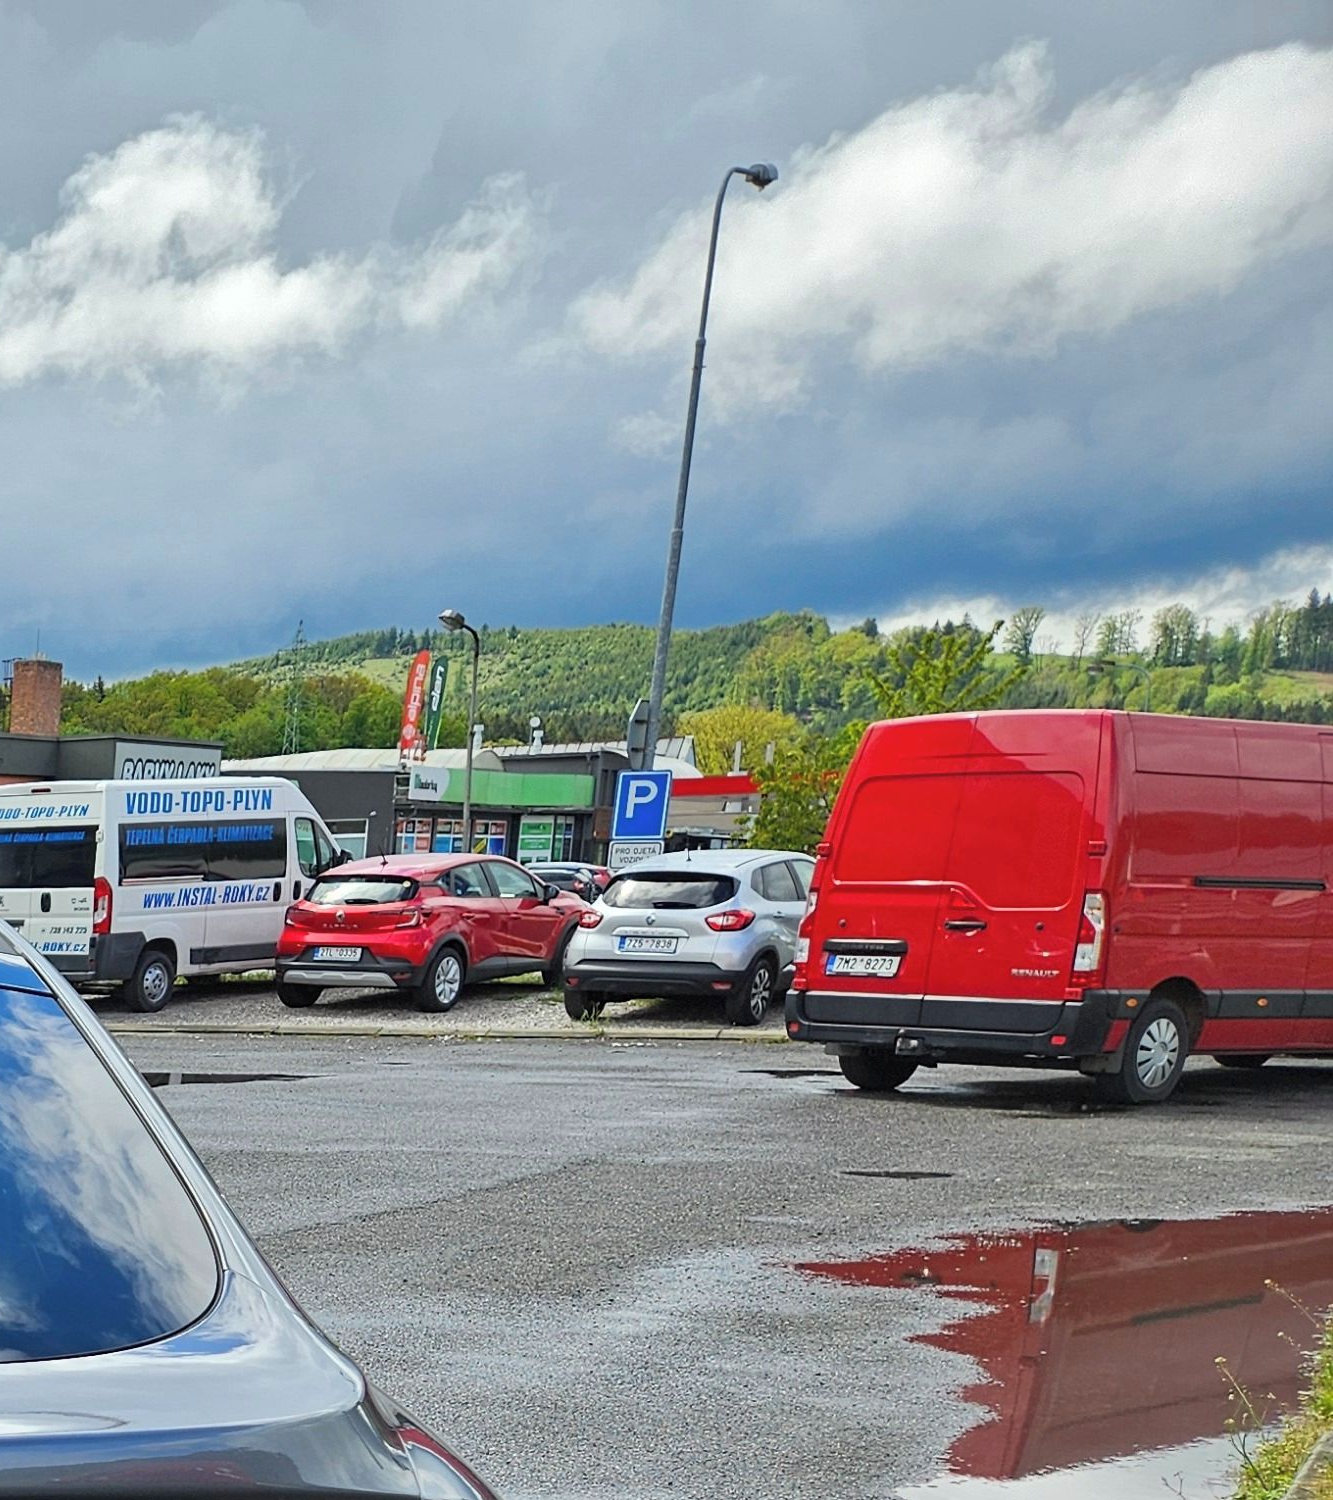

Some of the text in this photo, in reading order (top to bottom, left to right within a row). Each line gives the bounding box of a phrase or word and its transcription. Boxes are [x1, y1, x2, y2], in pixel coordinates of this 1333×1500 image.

[407, 664, 426, 722] alpina
[126, 788, 272, 815] VODO-TOPO-PLYN
[625, 780, 658, 818] P
[615, 847, 631, 855] PRO
[835, 957, 894, 971] 7M2 8273
